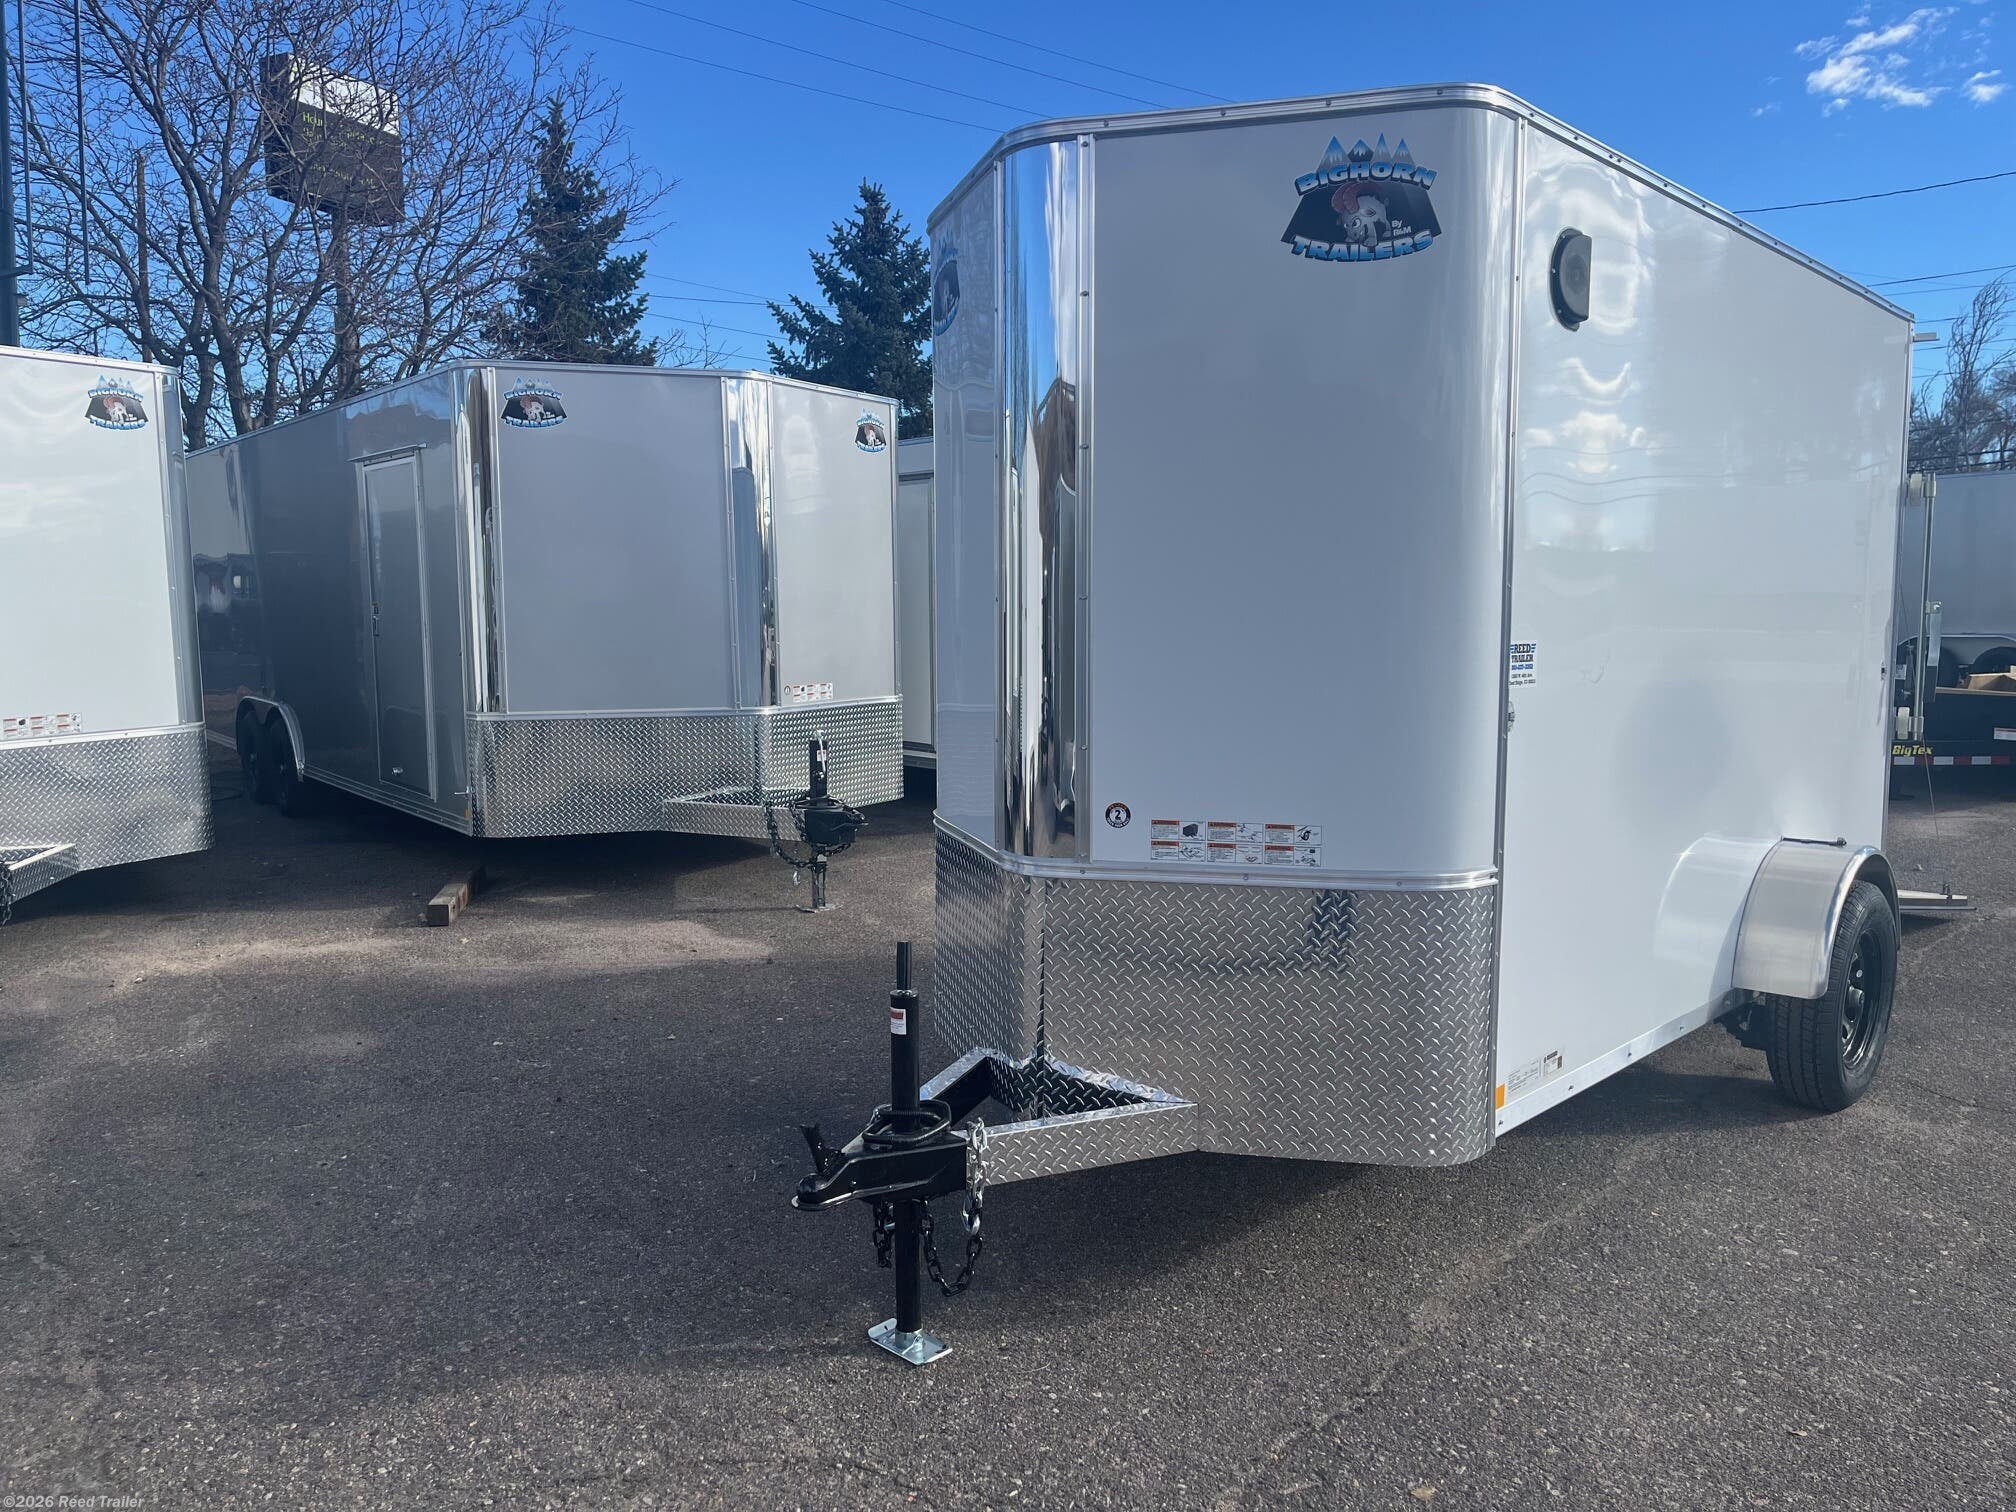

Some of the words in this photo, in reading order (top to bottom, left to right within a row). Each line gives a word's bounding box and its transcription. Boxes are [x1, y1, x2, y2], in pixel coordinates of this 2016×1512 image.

[1295, 161, 1437, 195] BIGHORN
[1291, 230, 1434, 262] TRAILERS
[1514, 643, 1531, 653] REED
[1892, 744, 1933, 756] BigTex
[1114, 809, 1122, 820] 2
